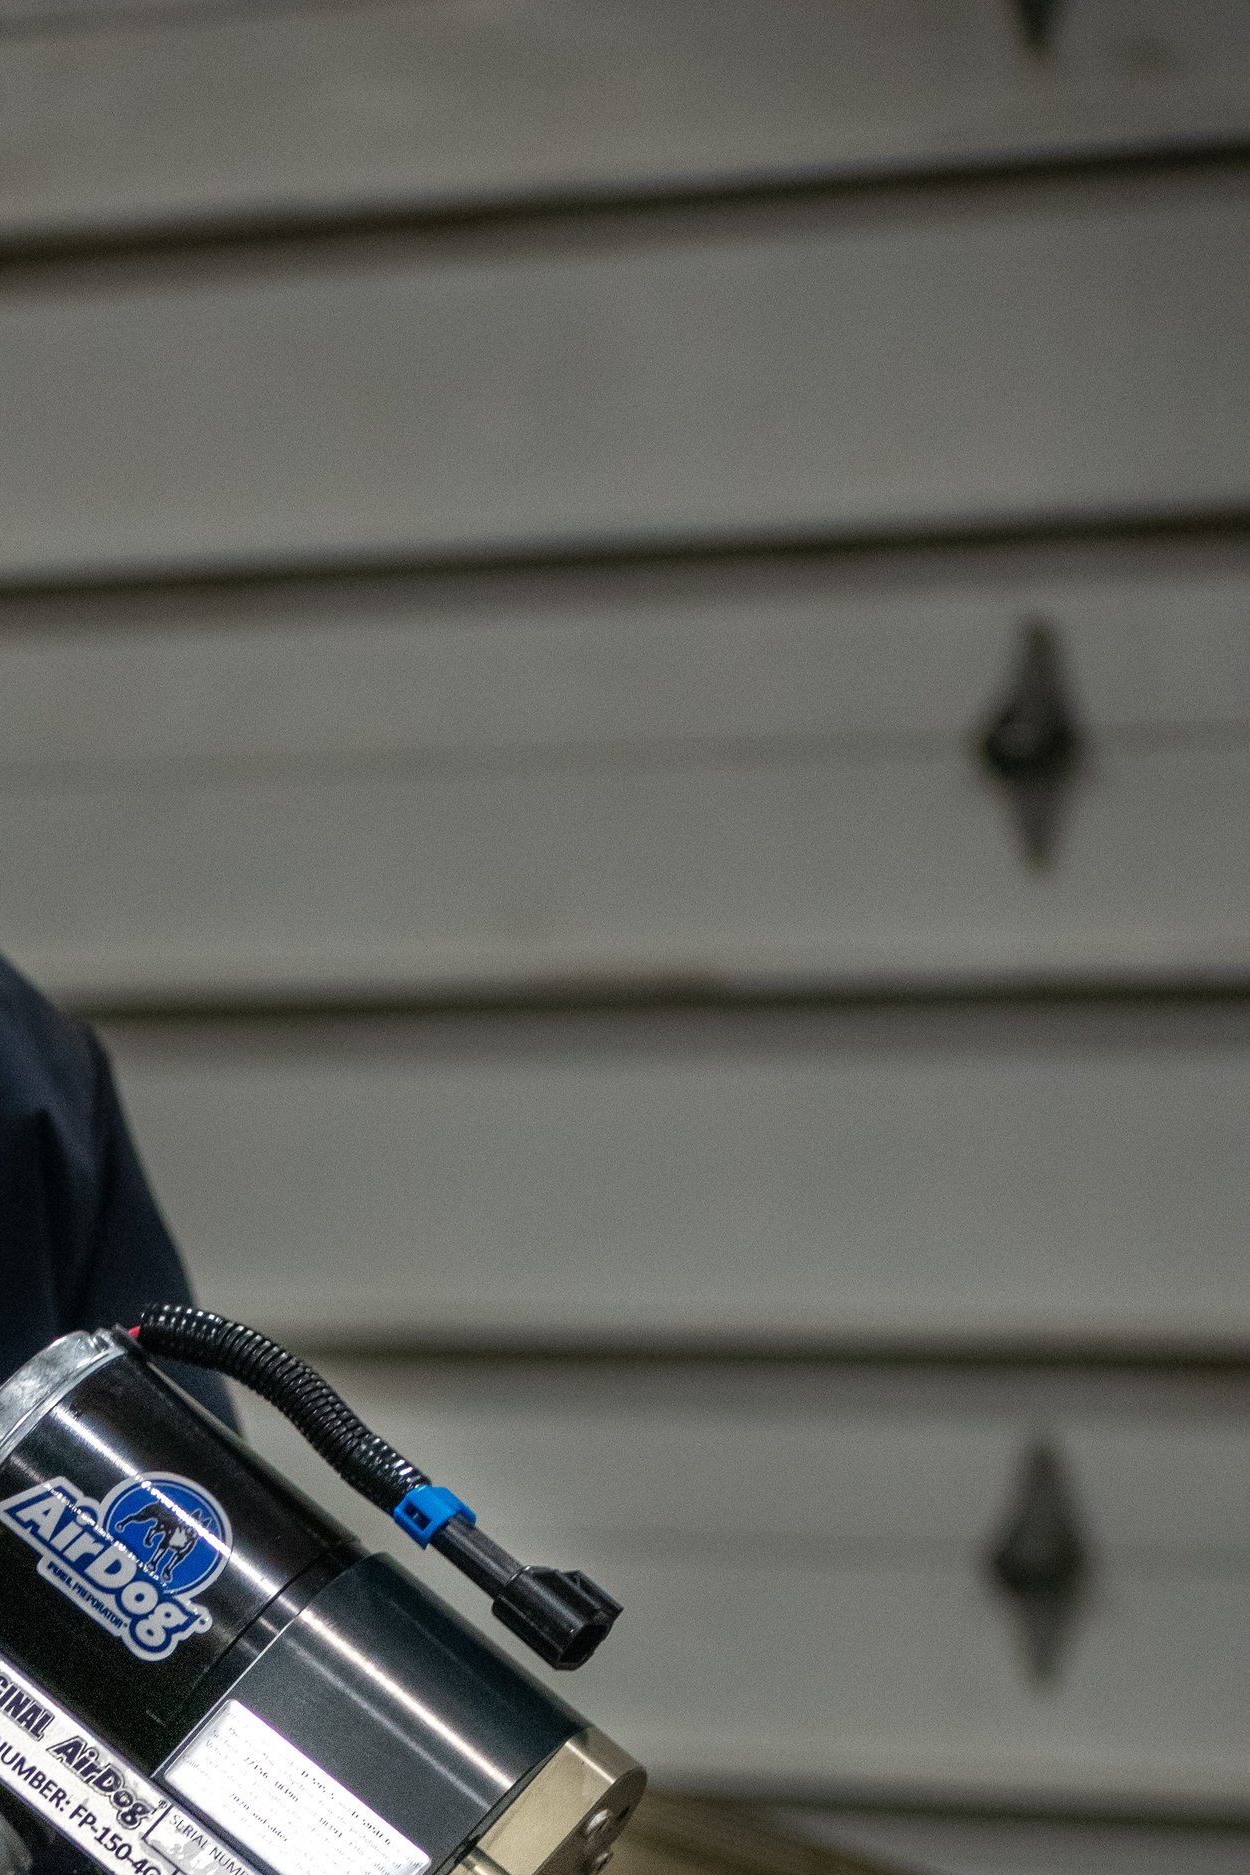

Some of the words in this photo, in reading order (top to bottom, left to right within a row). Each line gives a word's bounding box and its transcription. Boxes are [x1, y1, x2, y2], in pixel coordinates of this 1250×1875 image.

[2, 1486, 196, 1652] AirDog
[46, 1738, 157, 1830] AirDog
[168, 1812, 210, 1851] SERIAL
